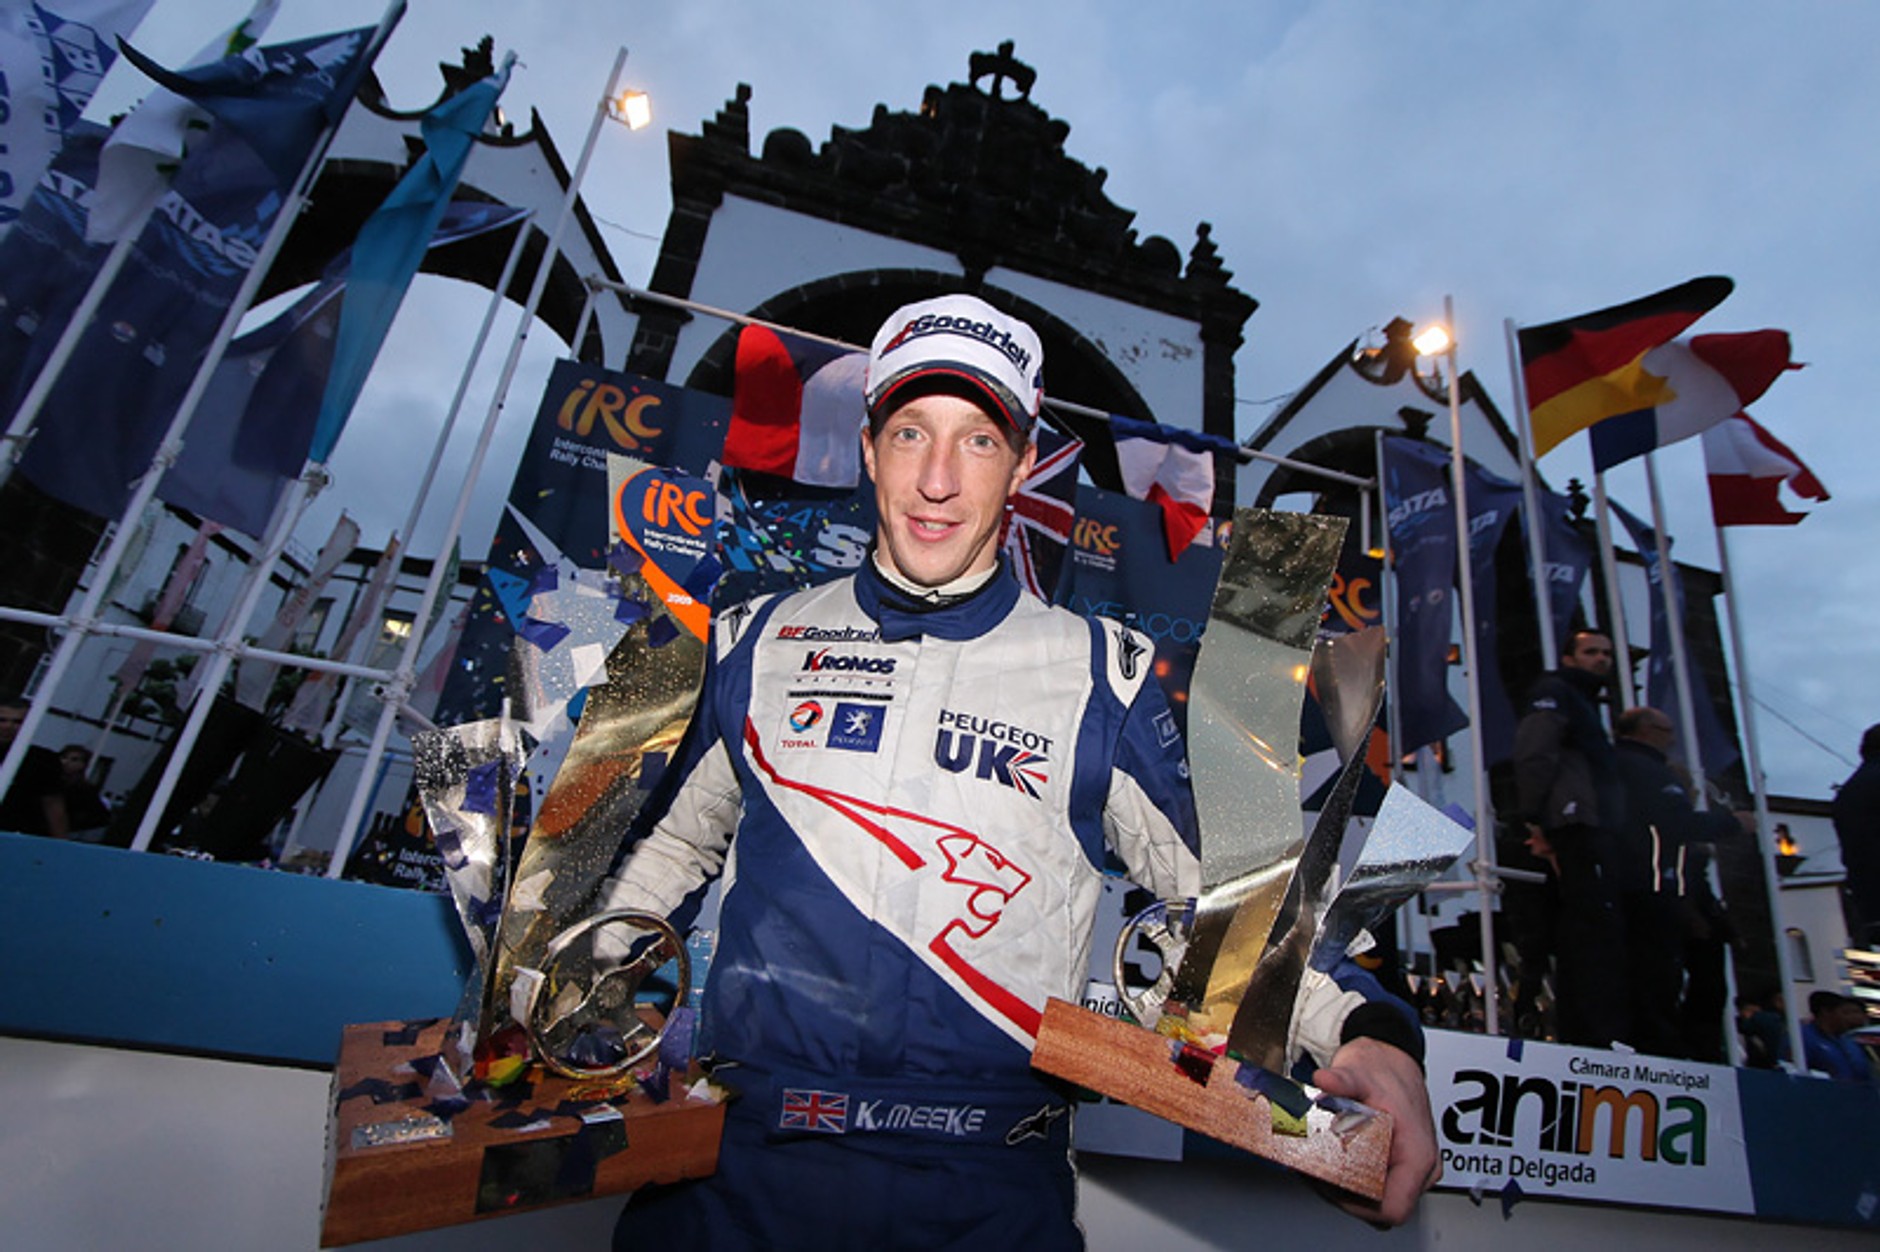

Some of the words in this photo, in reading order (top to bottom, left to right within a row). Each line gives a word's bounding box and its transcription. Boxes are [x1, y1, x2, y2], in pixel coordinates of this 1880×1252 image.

[550, 449, 578, 467] Rally
[1328, 571, 1380, 630] RC
[781, 739, 817, 748] TOTAL
[938, 709, 1054, 754] PEUGEOT
[934, 728, 1048, 800] UK
[1633, 1064, 1710, 1091] Municipal
[1441, 1069, 1707, 1166] anima
[1439, 1147, 1502, 1176] Ponta
[1508, 1155, 1597, 1187] Delgada
